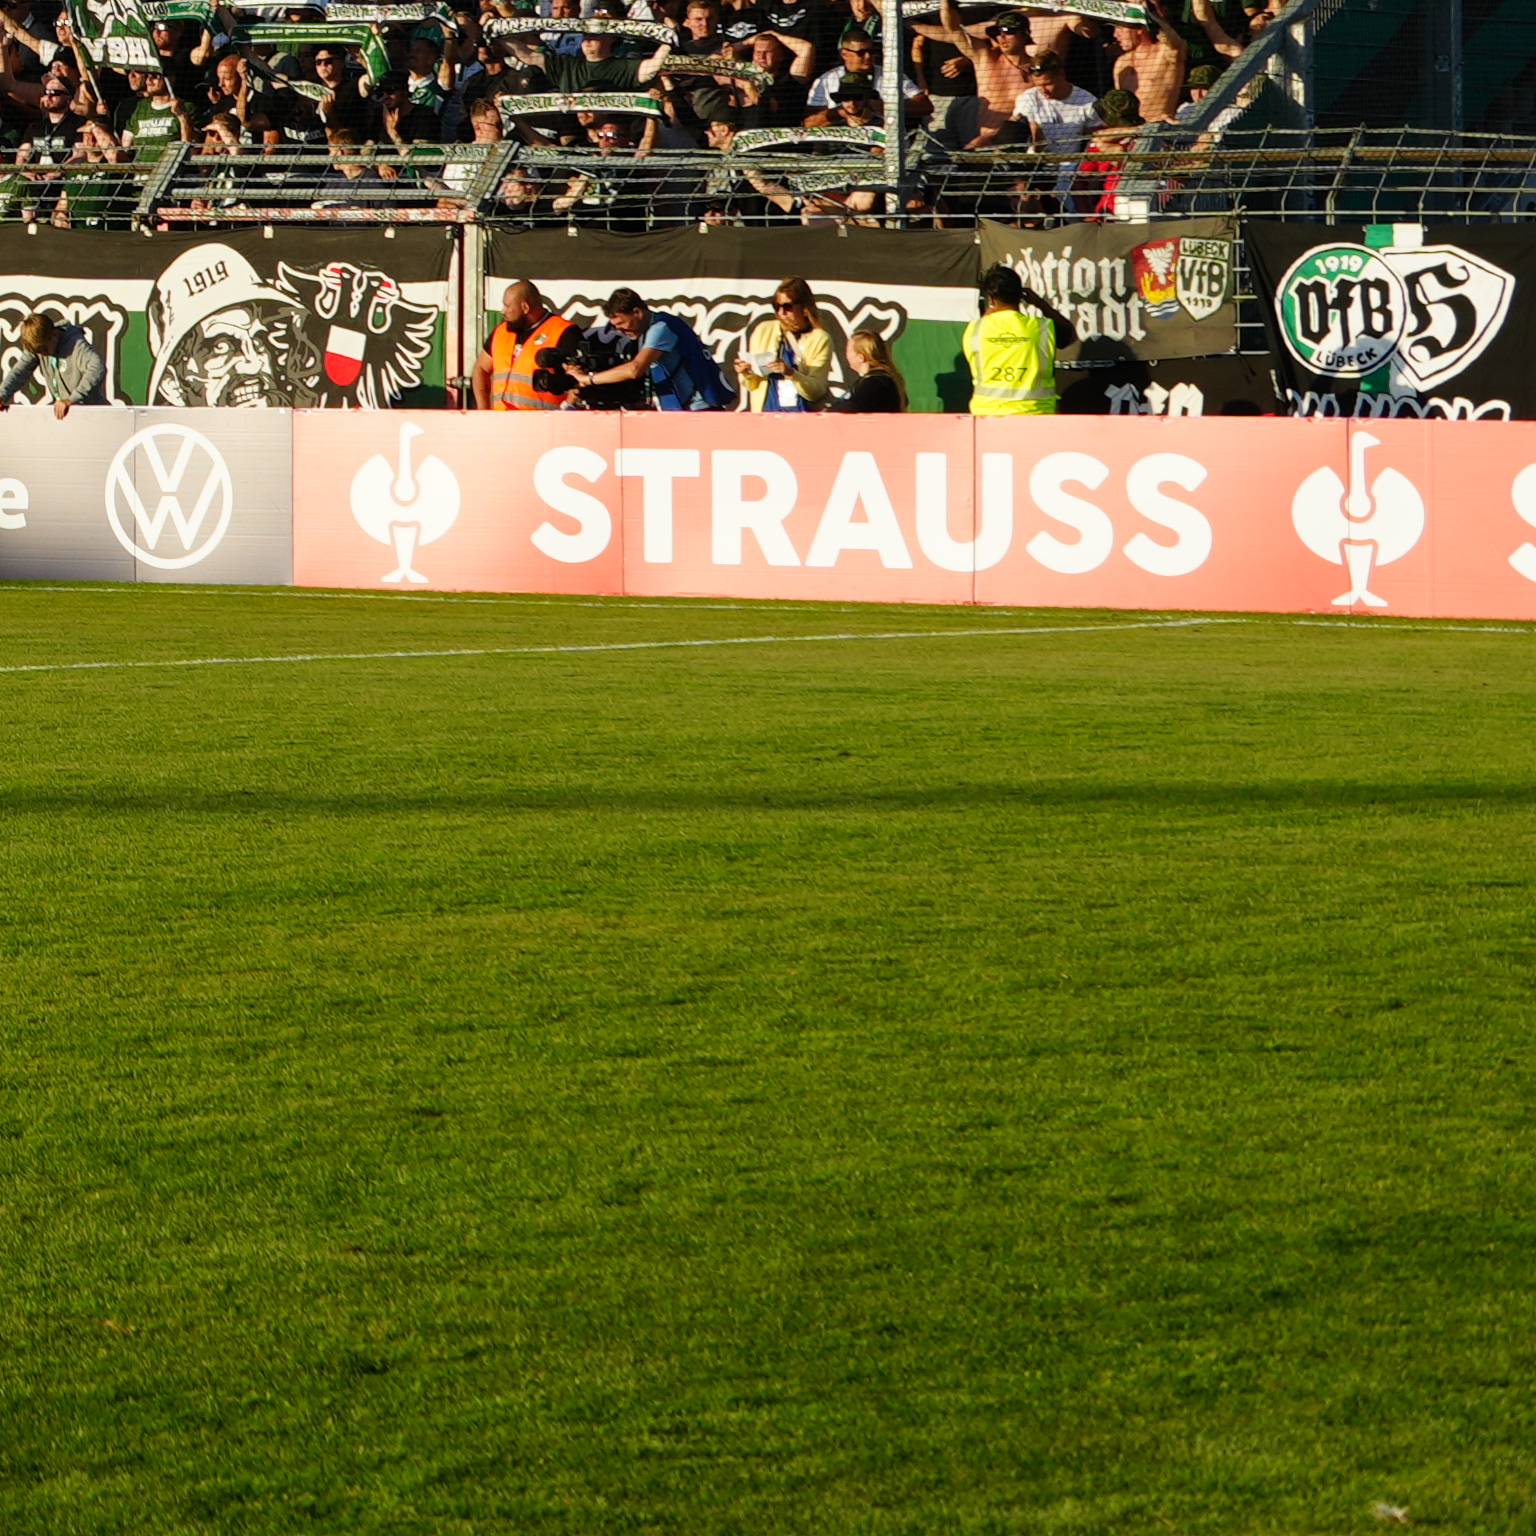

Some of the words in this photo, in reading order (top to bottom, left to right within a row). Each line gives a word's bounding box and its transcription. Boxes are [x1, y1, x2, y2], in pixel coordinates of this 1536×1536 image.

[1179, 238, 1229, 258] LÜBECK
[1314, 253, 1364, 276] 1919
[182, 258, 231, 297] 1919
[1296, 277, 1395, 346] VfB
[1312, 345, 1379, 370] LÜBECK
[990, 366, 1029, 383] 287
[530, 445, 1213, 578] STRAUSS
